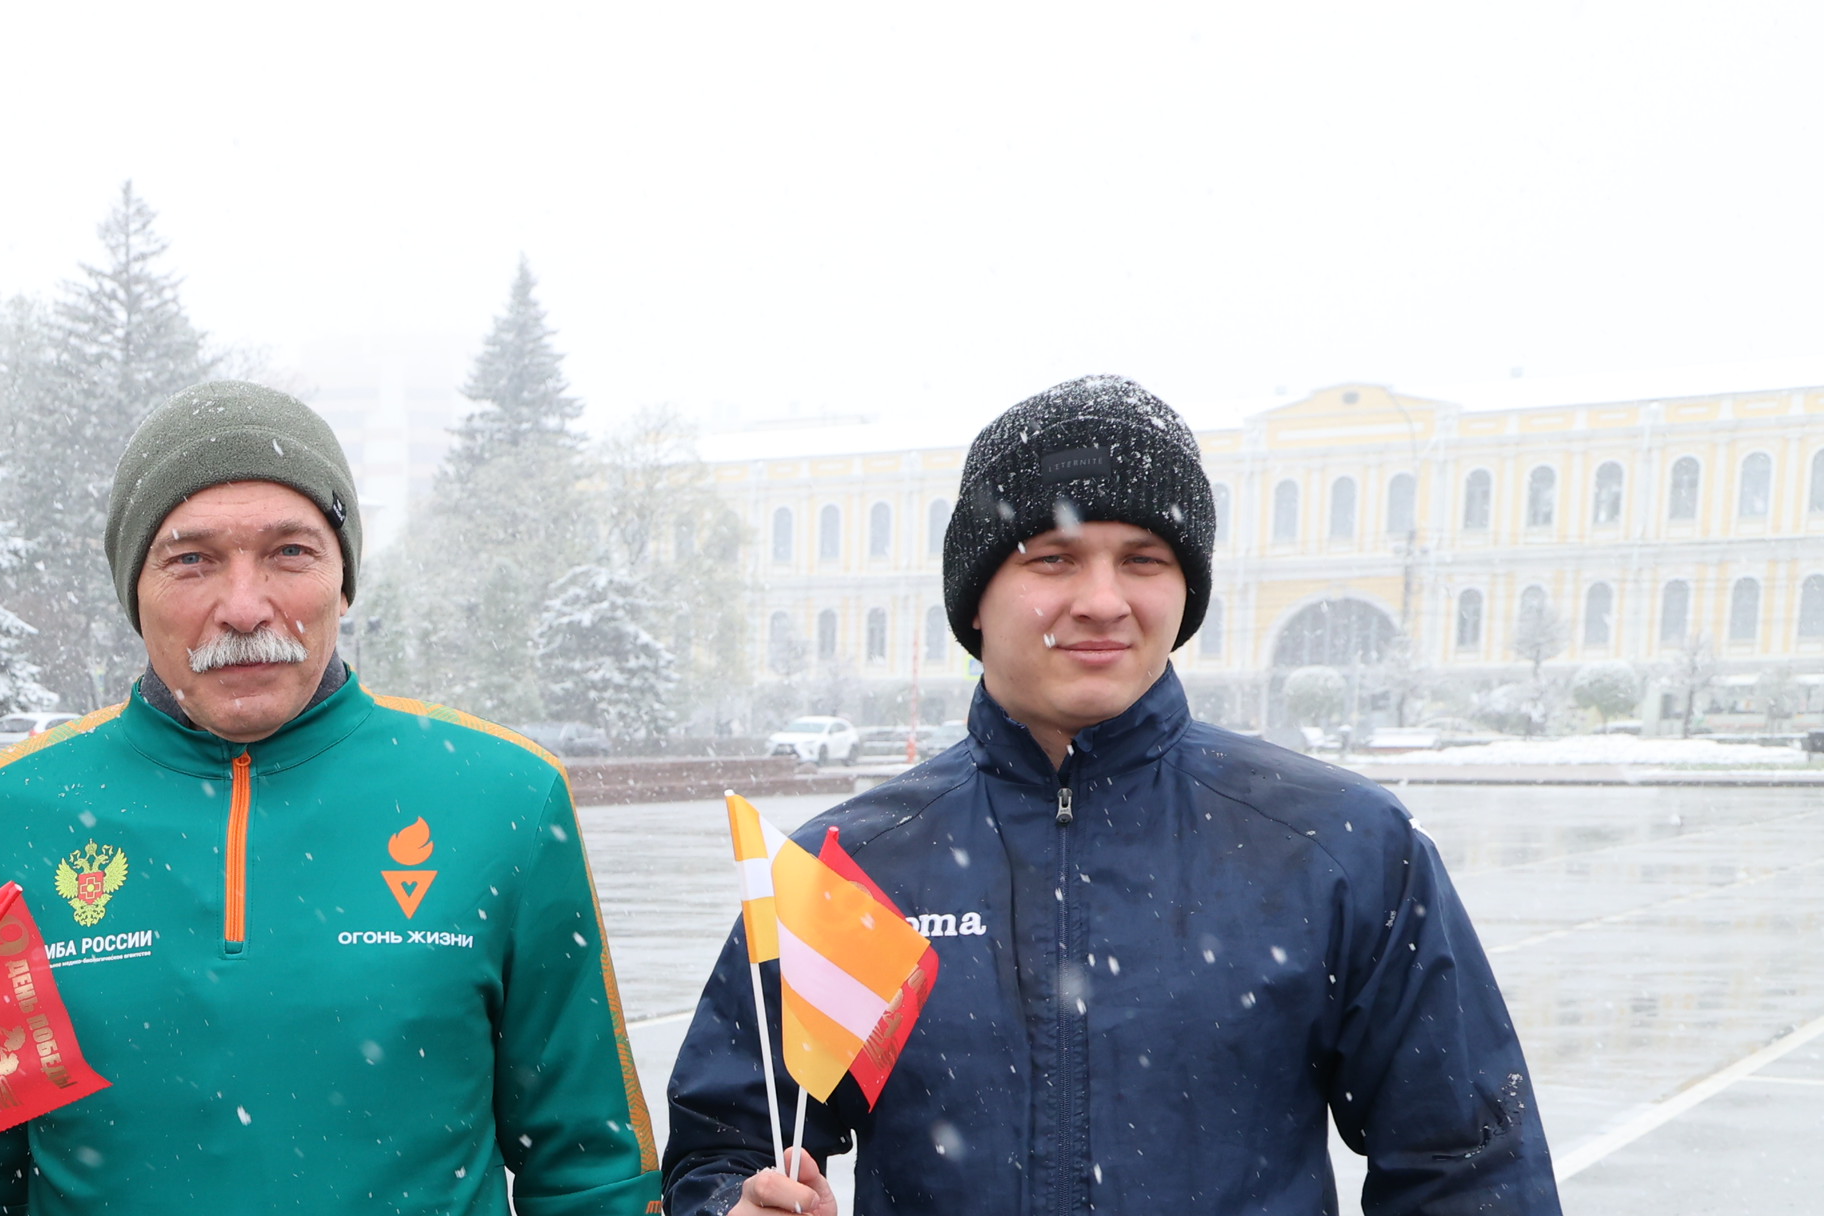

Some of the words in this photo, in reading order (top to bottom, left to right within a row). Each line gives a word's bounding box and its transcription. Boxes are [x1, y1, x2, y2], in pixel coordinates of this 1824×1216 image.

[44, 940, 77, 960] МБА
[81, 930, 153, 954] РОССИИ
[337, 930, 403, 945] ОГОНЬ
[406, 930, 474, 949] ЖИЗНИ
[5, 959, 38, 1013] ДЕНЬ
[26, 1013, 78, 1090] ПОБЕДЫ
